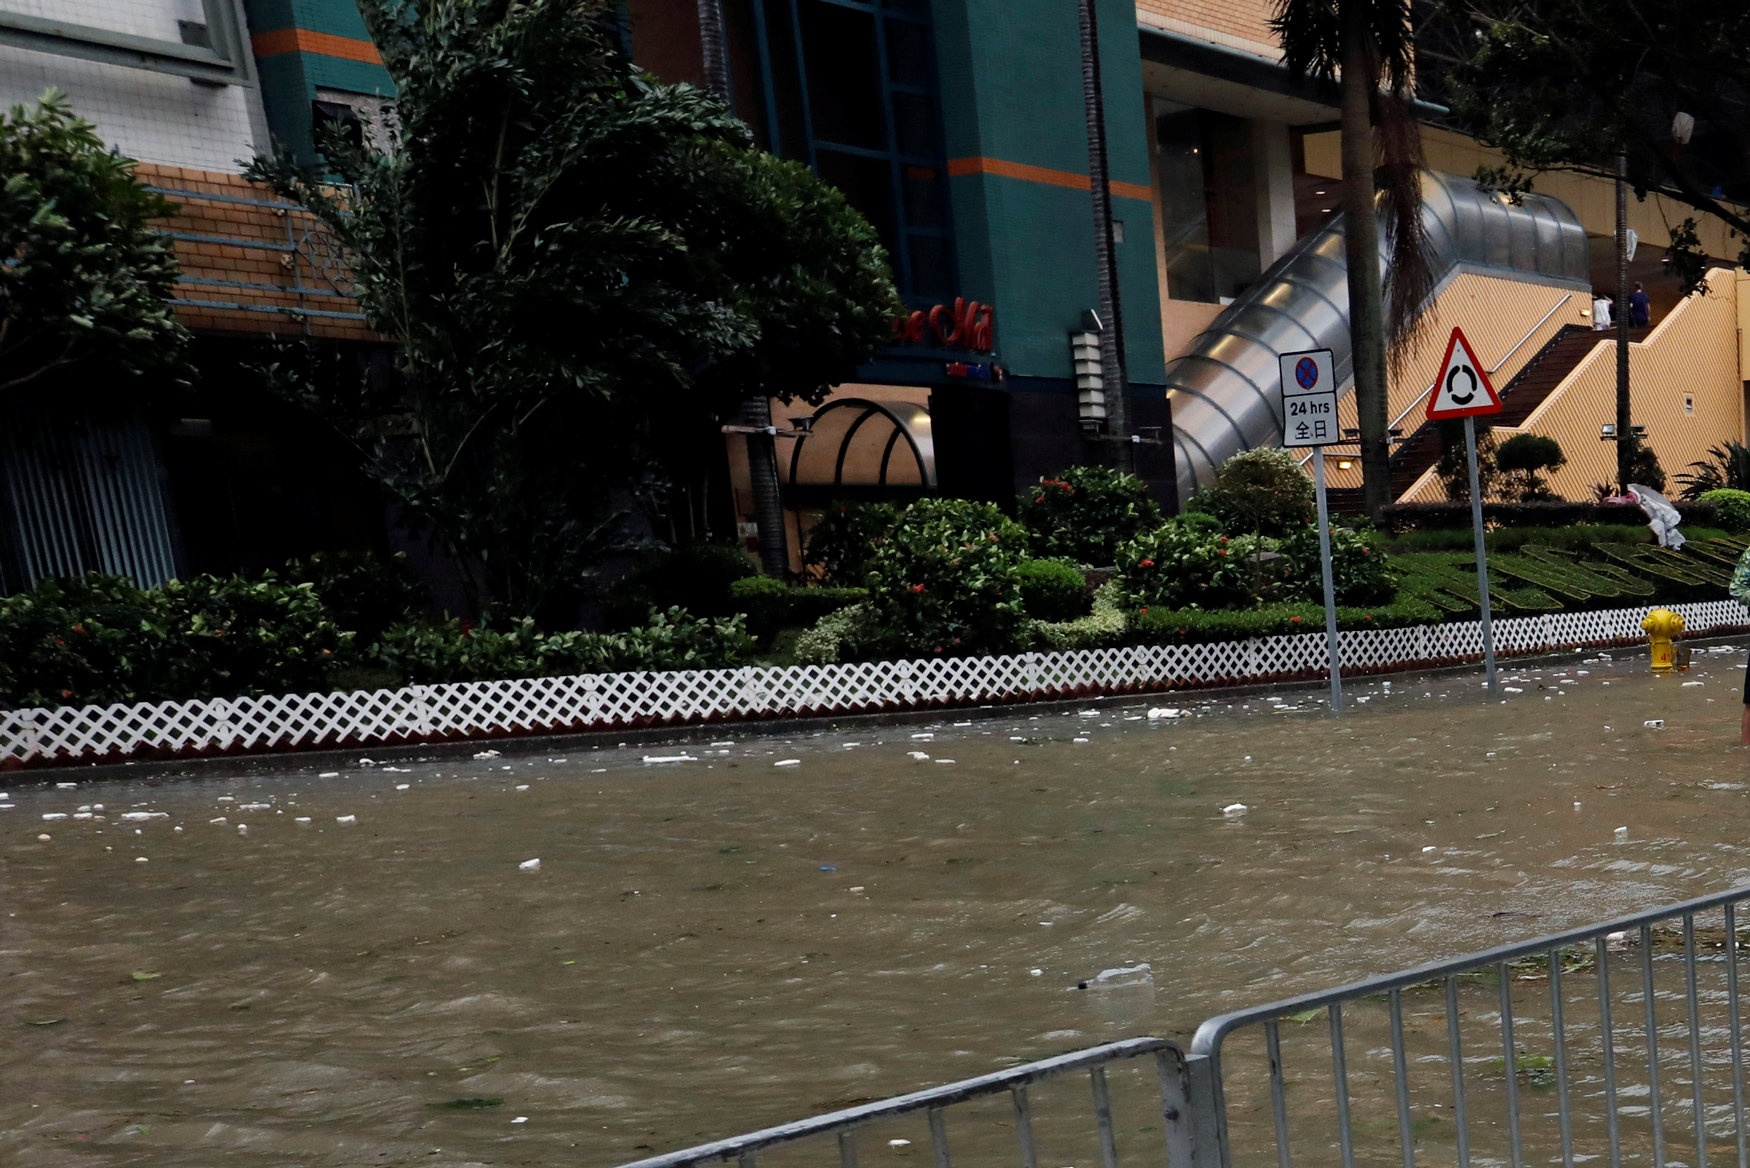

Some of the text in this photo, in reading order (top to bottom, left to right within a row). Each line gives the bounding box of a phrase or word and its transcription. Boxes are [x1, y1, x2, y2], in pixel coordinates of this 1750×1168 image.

[1290, 401, 1330, 416] 24 hrs
[1295, 420, 1327, 440] 全日
